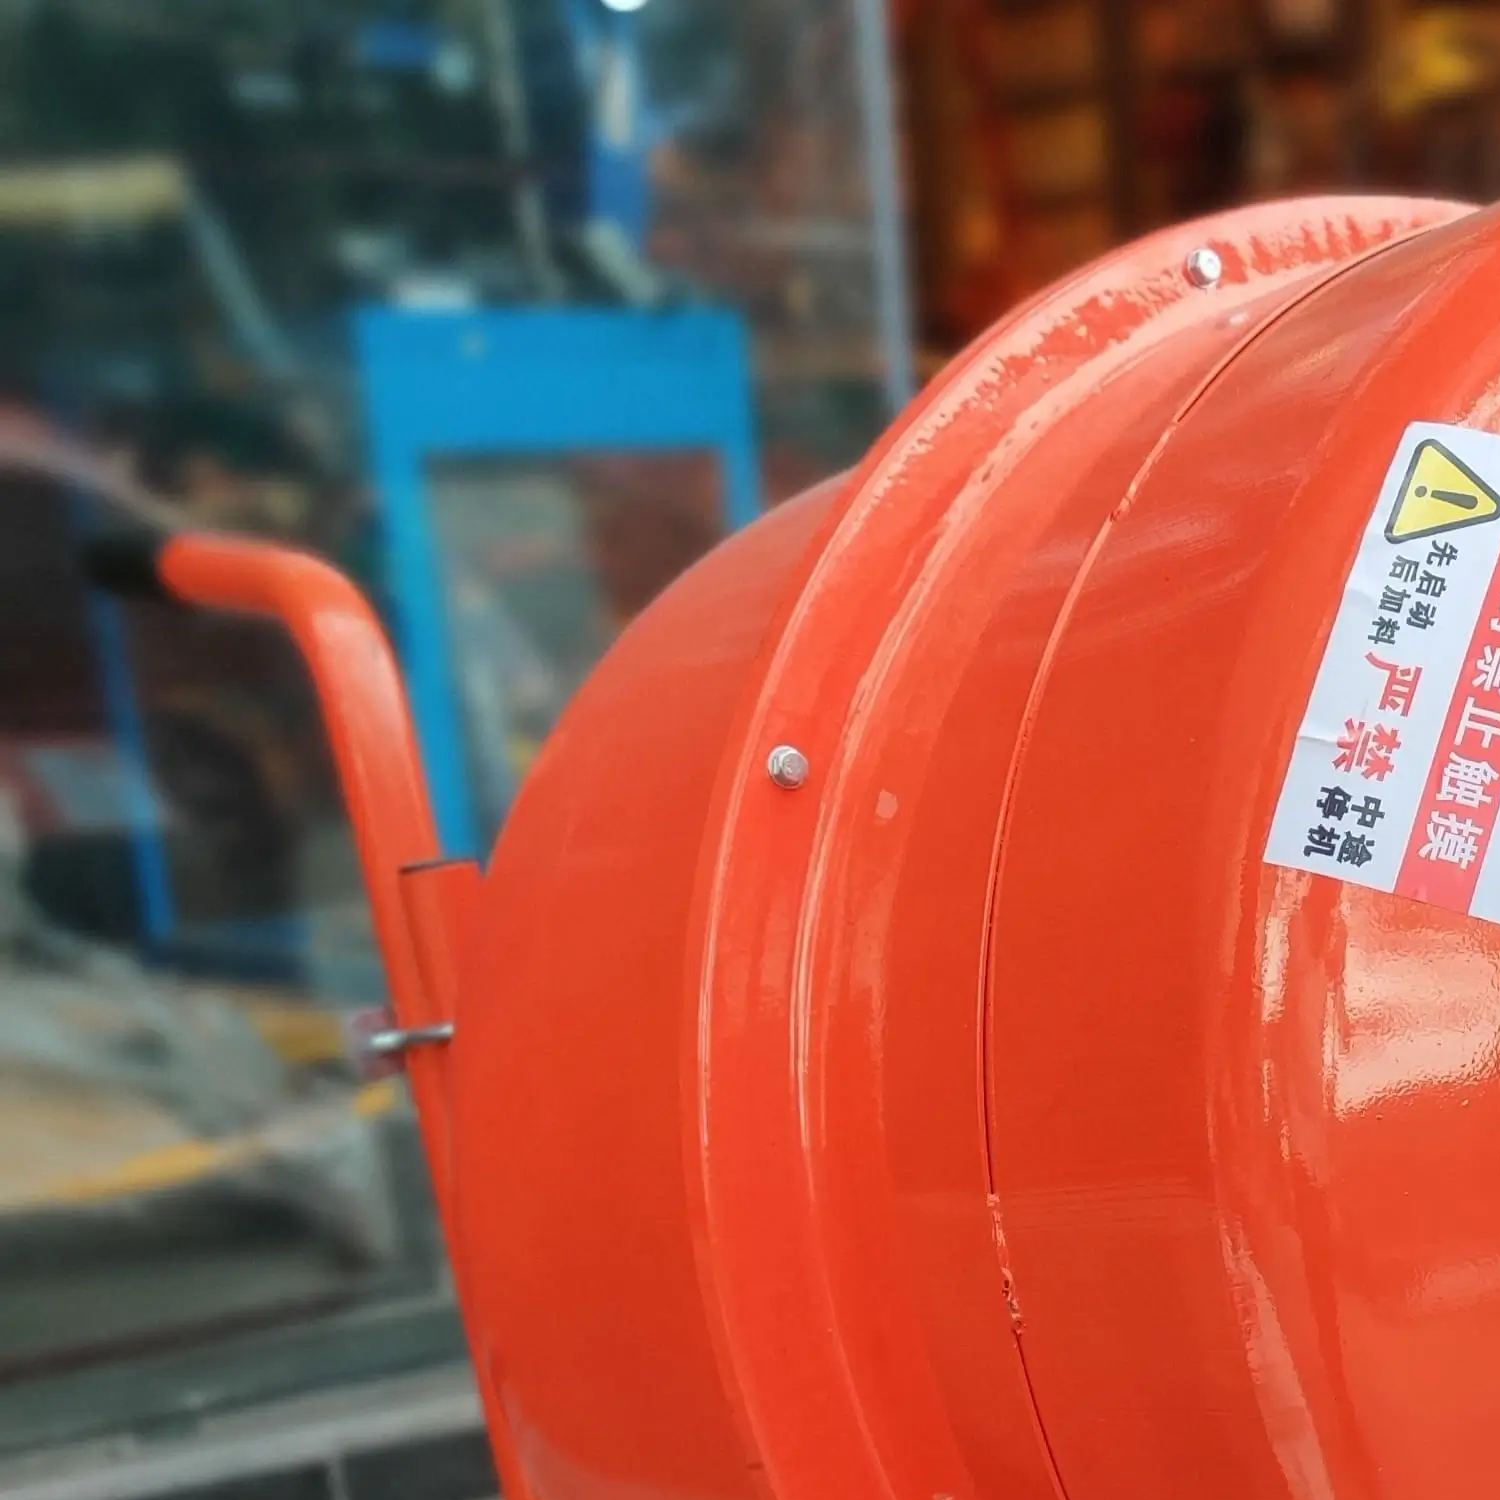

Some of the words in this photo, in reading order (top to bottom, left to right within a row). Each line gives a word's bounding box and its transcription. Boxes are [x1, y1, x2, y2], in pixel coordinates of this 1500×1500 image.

[1368, 555, 1420, 644] 后加料
[1406, 540, 1459, 629] 先启动
[1332, 652, 1423, 782] 严禁
[1303, 786, 1353, 857] 停机
[1337, 796, 1385, 868] 中途
